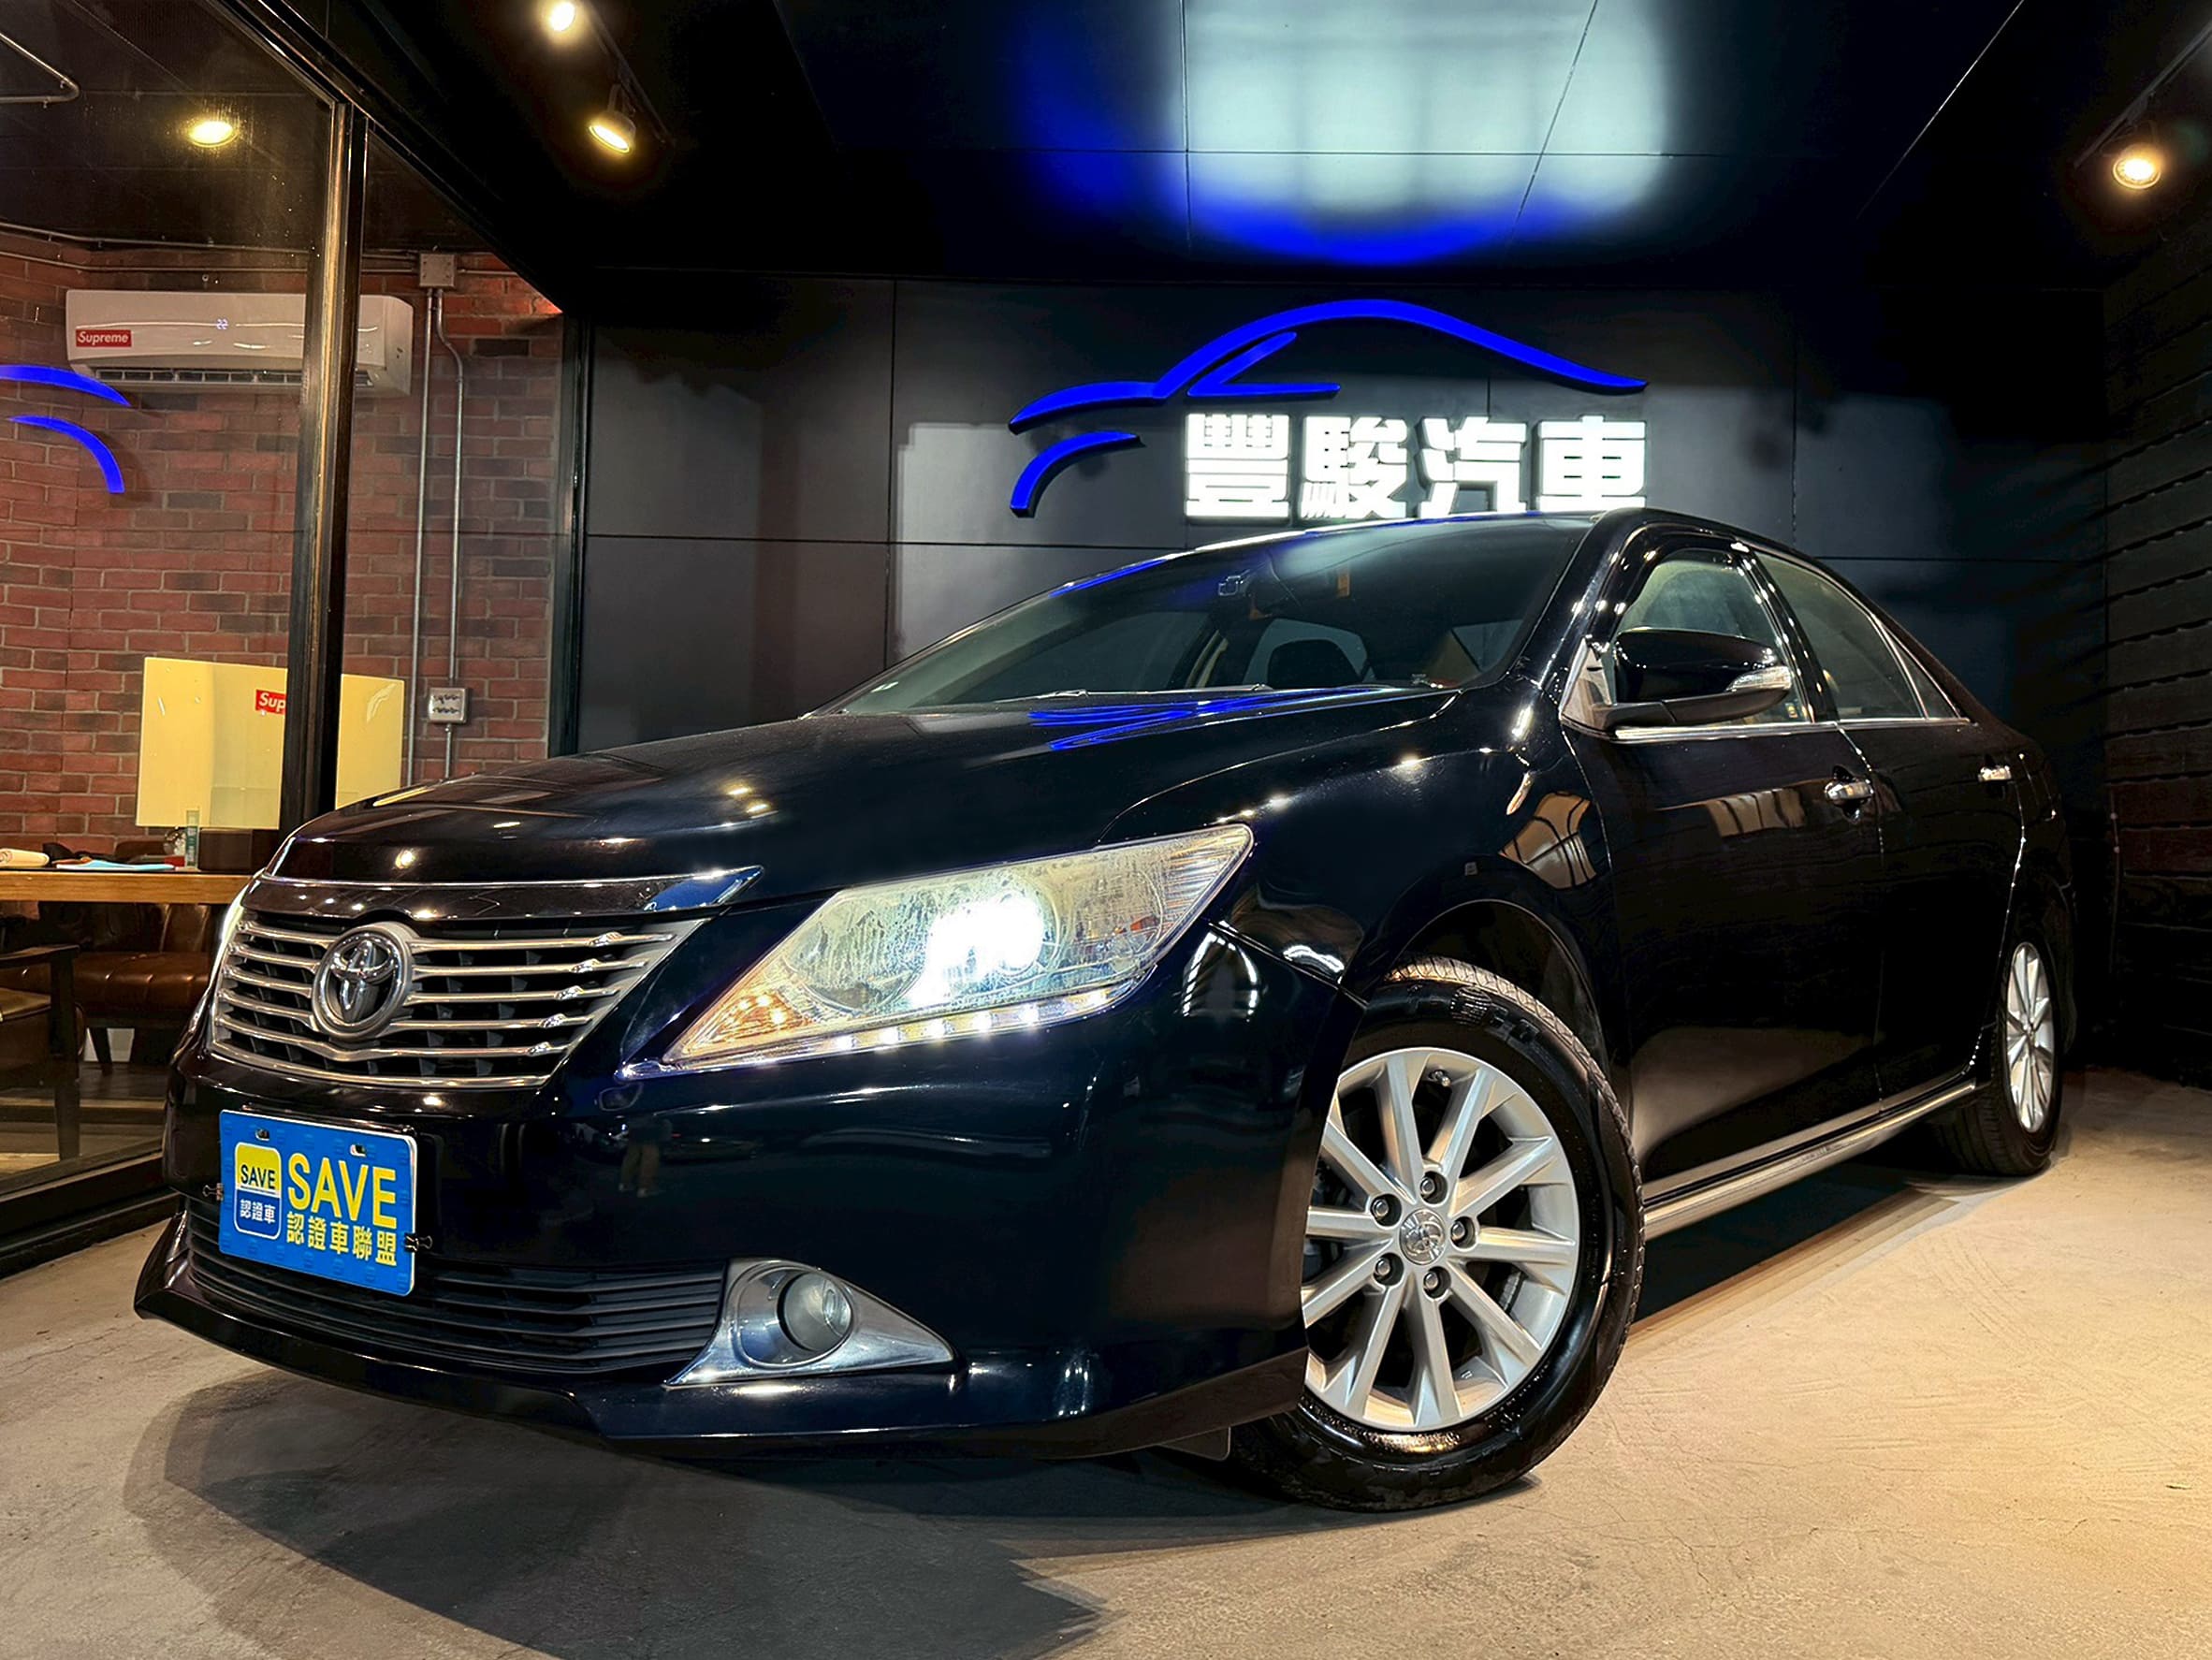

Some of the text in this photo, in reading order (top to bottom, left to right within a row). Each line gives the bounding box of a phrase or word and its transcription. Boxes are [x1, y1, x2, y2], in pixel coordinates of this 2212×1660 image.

[77, 330, 129, 345] Supreme
[1186, 414, 1646, 518] 豐駿汽車
[240, 1164, 276, 1189] SAVE
[287, 1153, 398, 1230] SAVE
[240, 1198, 276, 1224] 認證車
[286, 1211, 398, 1267] 認證車聯盟
